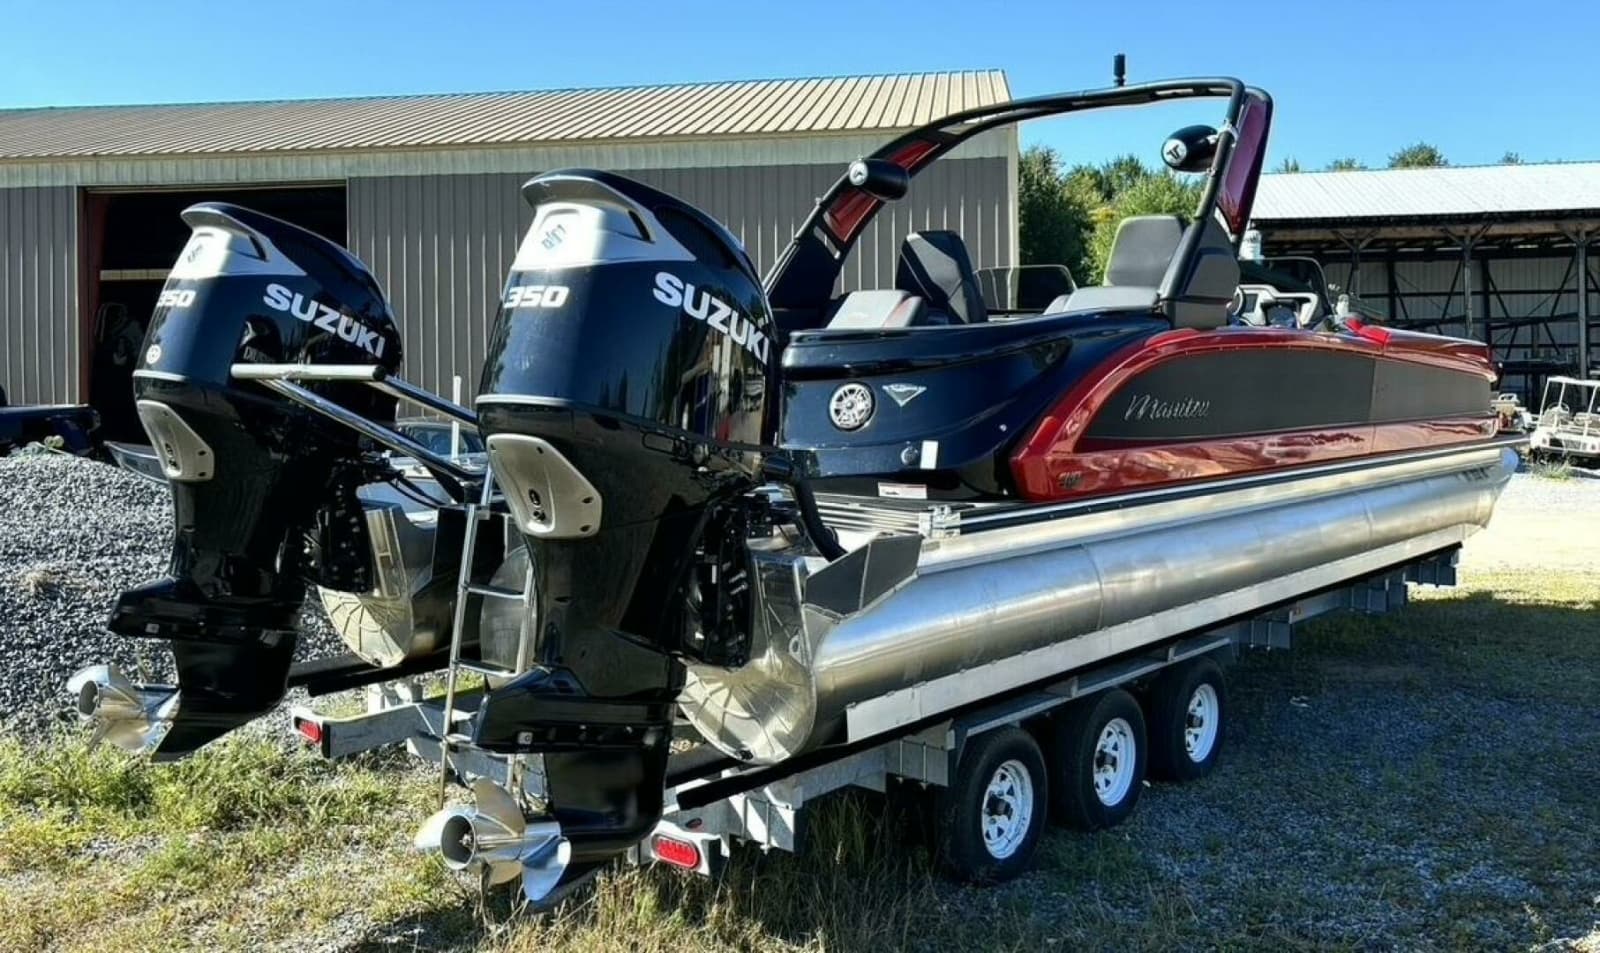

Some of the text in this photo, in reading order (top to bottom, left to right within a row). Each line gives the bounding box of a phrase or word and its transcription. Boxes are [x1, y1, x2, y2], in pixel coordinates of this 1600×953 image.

[263, 283, 386, 359] SUZUKI
[503, 285, 569, 308] 350
[652, 271, 770, 366] SUZUKI
[1124, 394, 1210, 420] Manitou
